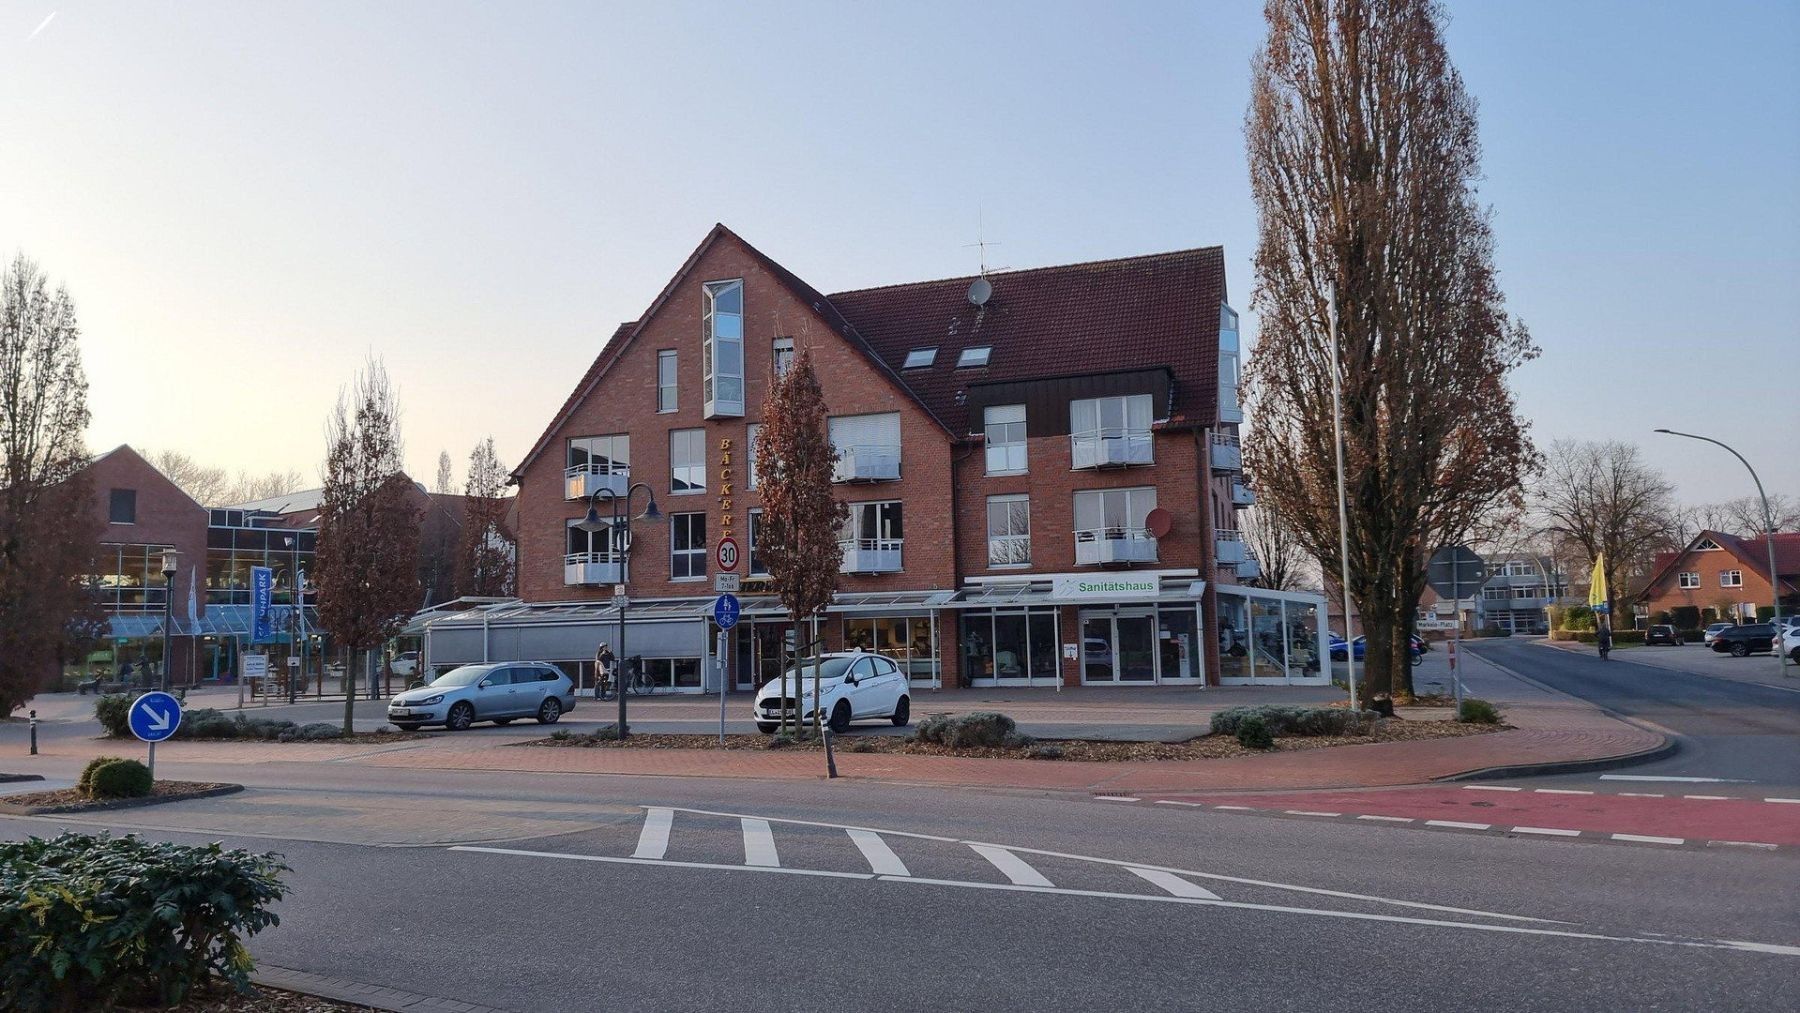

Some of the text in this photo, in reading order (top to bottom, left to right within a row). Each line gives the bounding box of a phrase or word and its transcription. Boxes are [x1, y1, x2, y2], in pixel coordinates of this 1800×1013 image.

[720, 438, 732, 539] BÄCKERE
[721, 547, 735, 563] 30
[1079, 581, 1154, 592] Sanitätshaus
